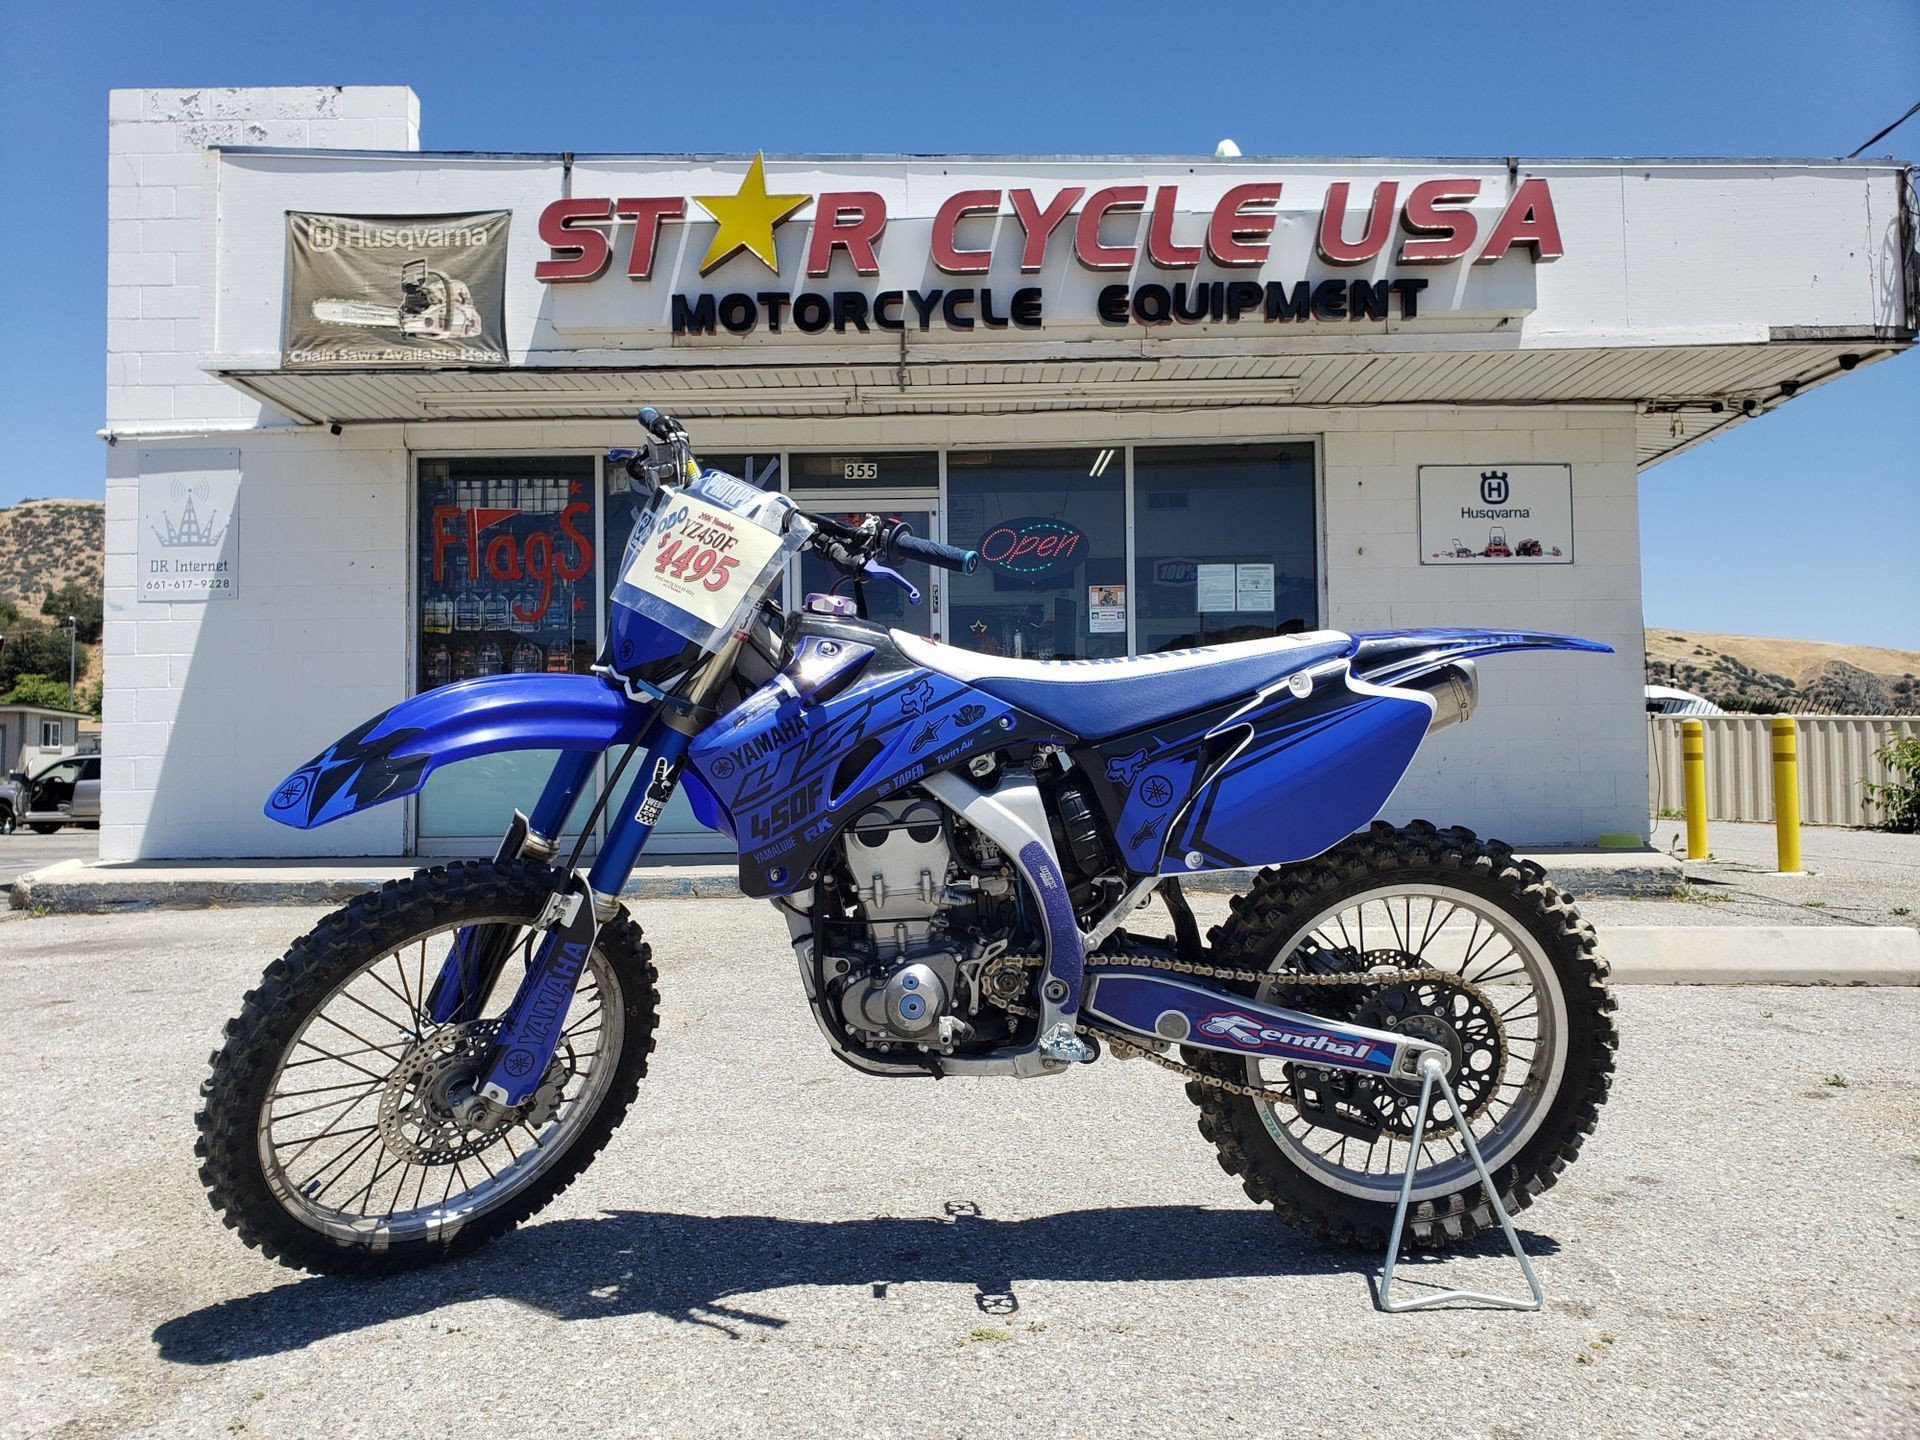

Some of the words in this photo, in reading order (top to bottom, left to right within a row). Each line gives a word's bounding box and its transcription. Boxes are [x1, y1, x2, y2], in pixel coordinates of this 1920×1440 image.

[344, 224, 488, 251] Husqvarna
[930, 182, 1283, 275] CYCLE
[1316, 178, 1565, 266] USA
[671, 287, 1043, 336] MOTORCYCLE
[1097, 278, 1428, 327] EQUIPMENT
[290, 348, 337, 363] Chain
[339, 349, 378, 362] Saws
[460, 347, 501, 362] Here
[846, 464, 876, 478] 355
[656, 505, 690, 534] OBO
[1461, 507, 1531, 520] Husqvarna
[679, 518, 739, 553] YZ450F
[982, 528, 1080, 565] Open
[150, 560, 169, 573] DR
[175, 560, 229, 573] Internet
[1160, 563, 1197, 580] 100%
[146, 578, 230, 590] 661-617-9228
[730, 714, 810, 770] YAMAHA
[936, 746, 960, 765] Twin
[960, 738, 975, 751] Air
[892, 763, 925, 790] TAPER
[751, 774, 824, 841] 450F
[803, 816, 834, 843] RK
[753, 835, 797, 863] YAMALUBE
[517, 942, 588, 1045] YAMAHA
[1201, 1015, 1370, 1059] Renthal
